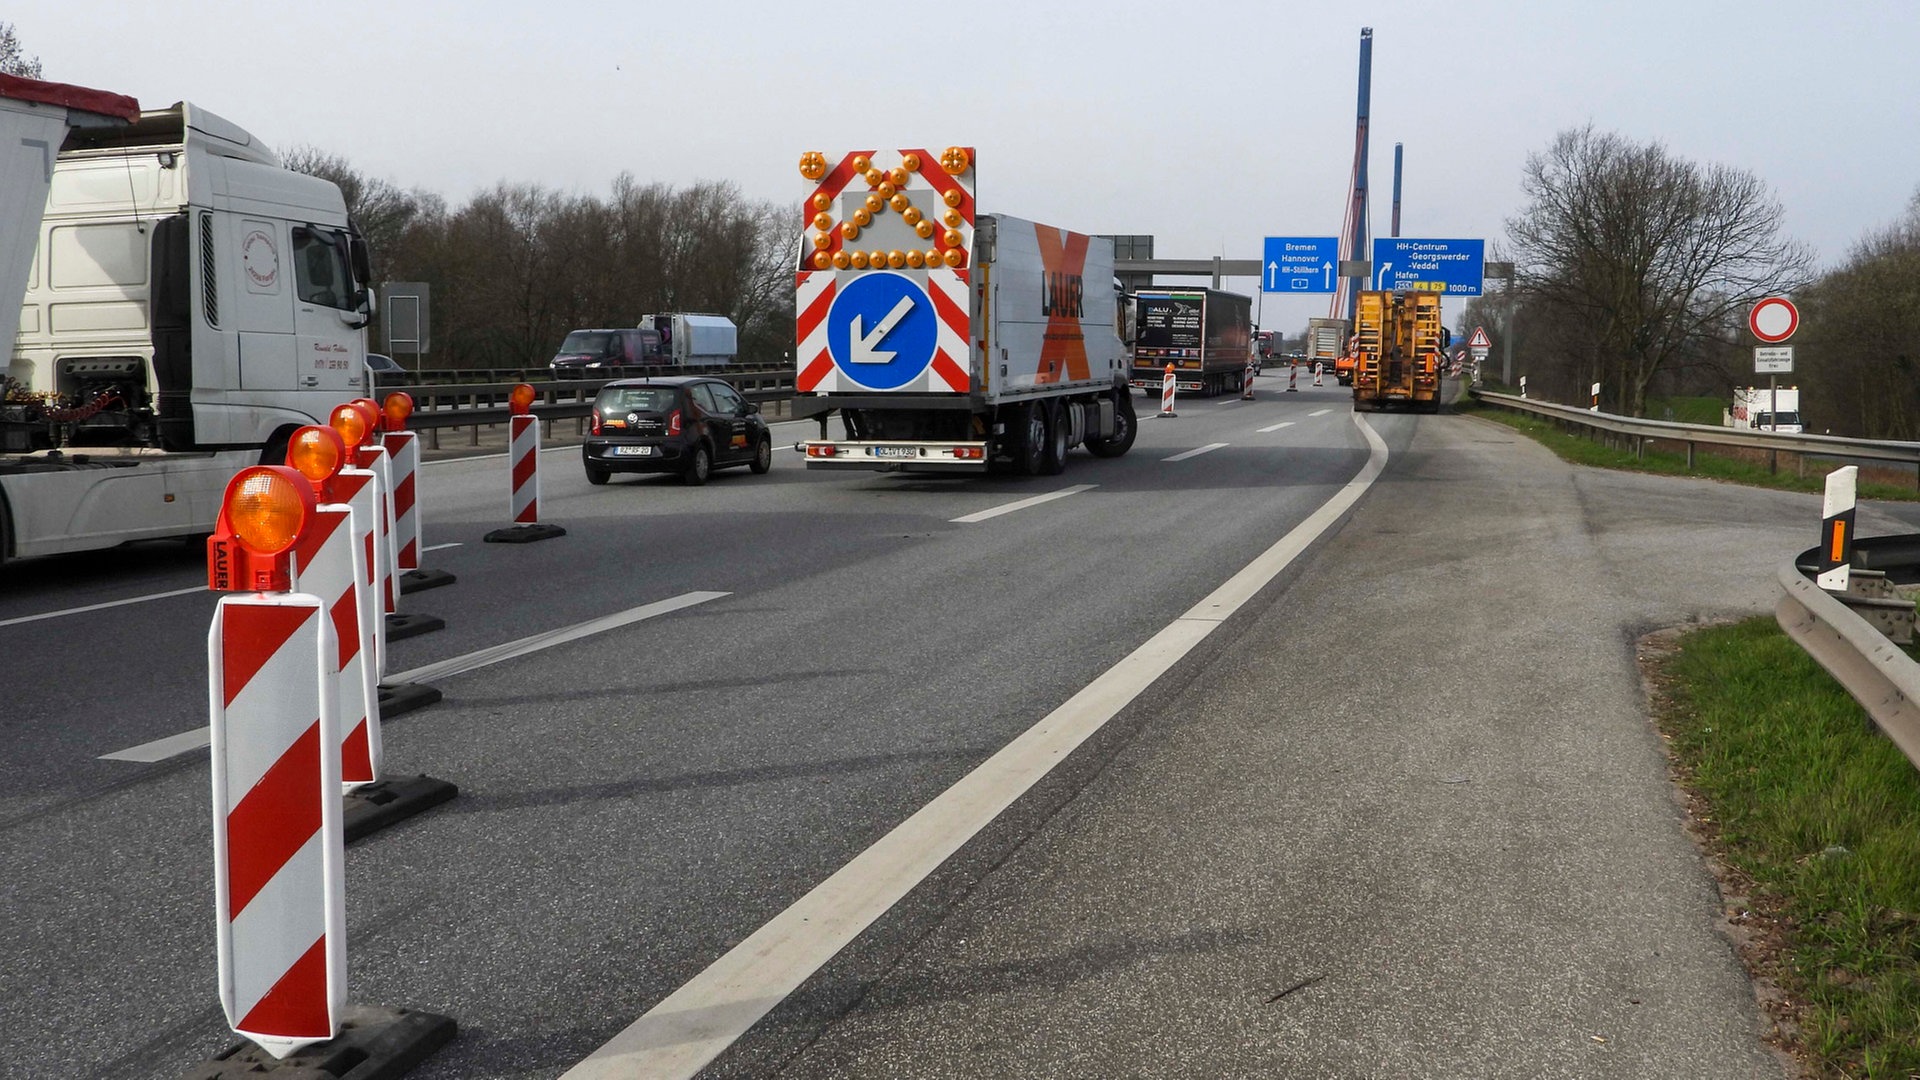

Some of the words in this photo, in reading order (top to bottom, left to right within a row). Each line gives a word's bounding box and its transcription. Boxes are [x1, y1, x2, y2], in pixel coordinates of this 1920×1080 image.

[1281, 254, 1319, 262] Hannover
[1395, 271, 1419, 279] Hafen
[1449, 284, 1468, 292] 1000
[1042, 270, 1084, 318] LAUER
[217, 541, 228, 588] LAUER
